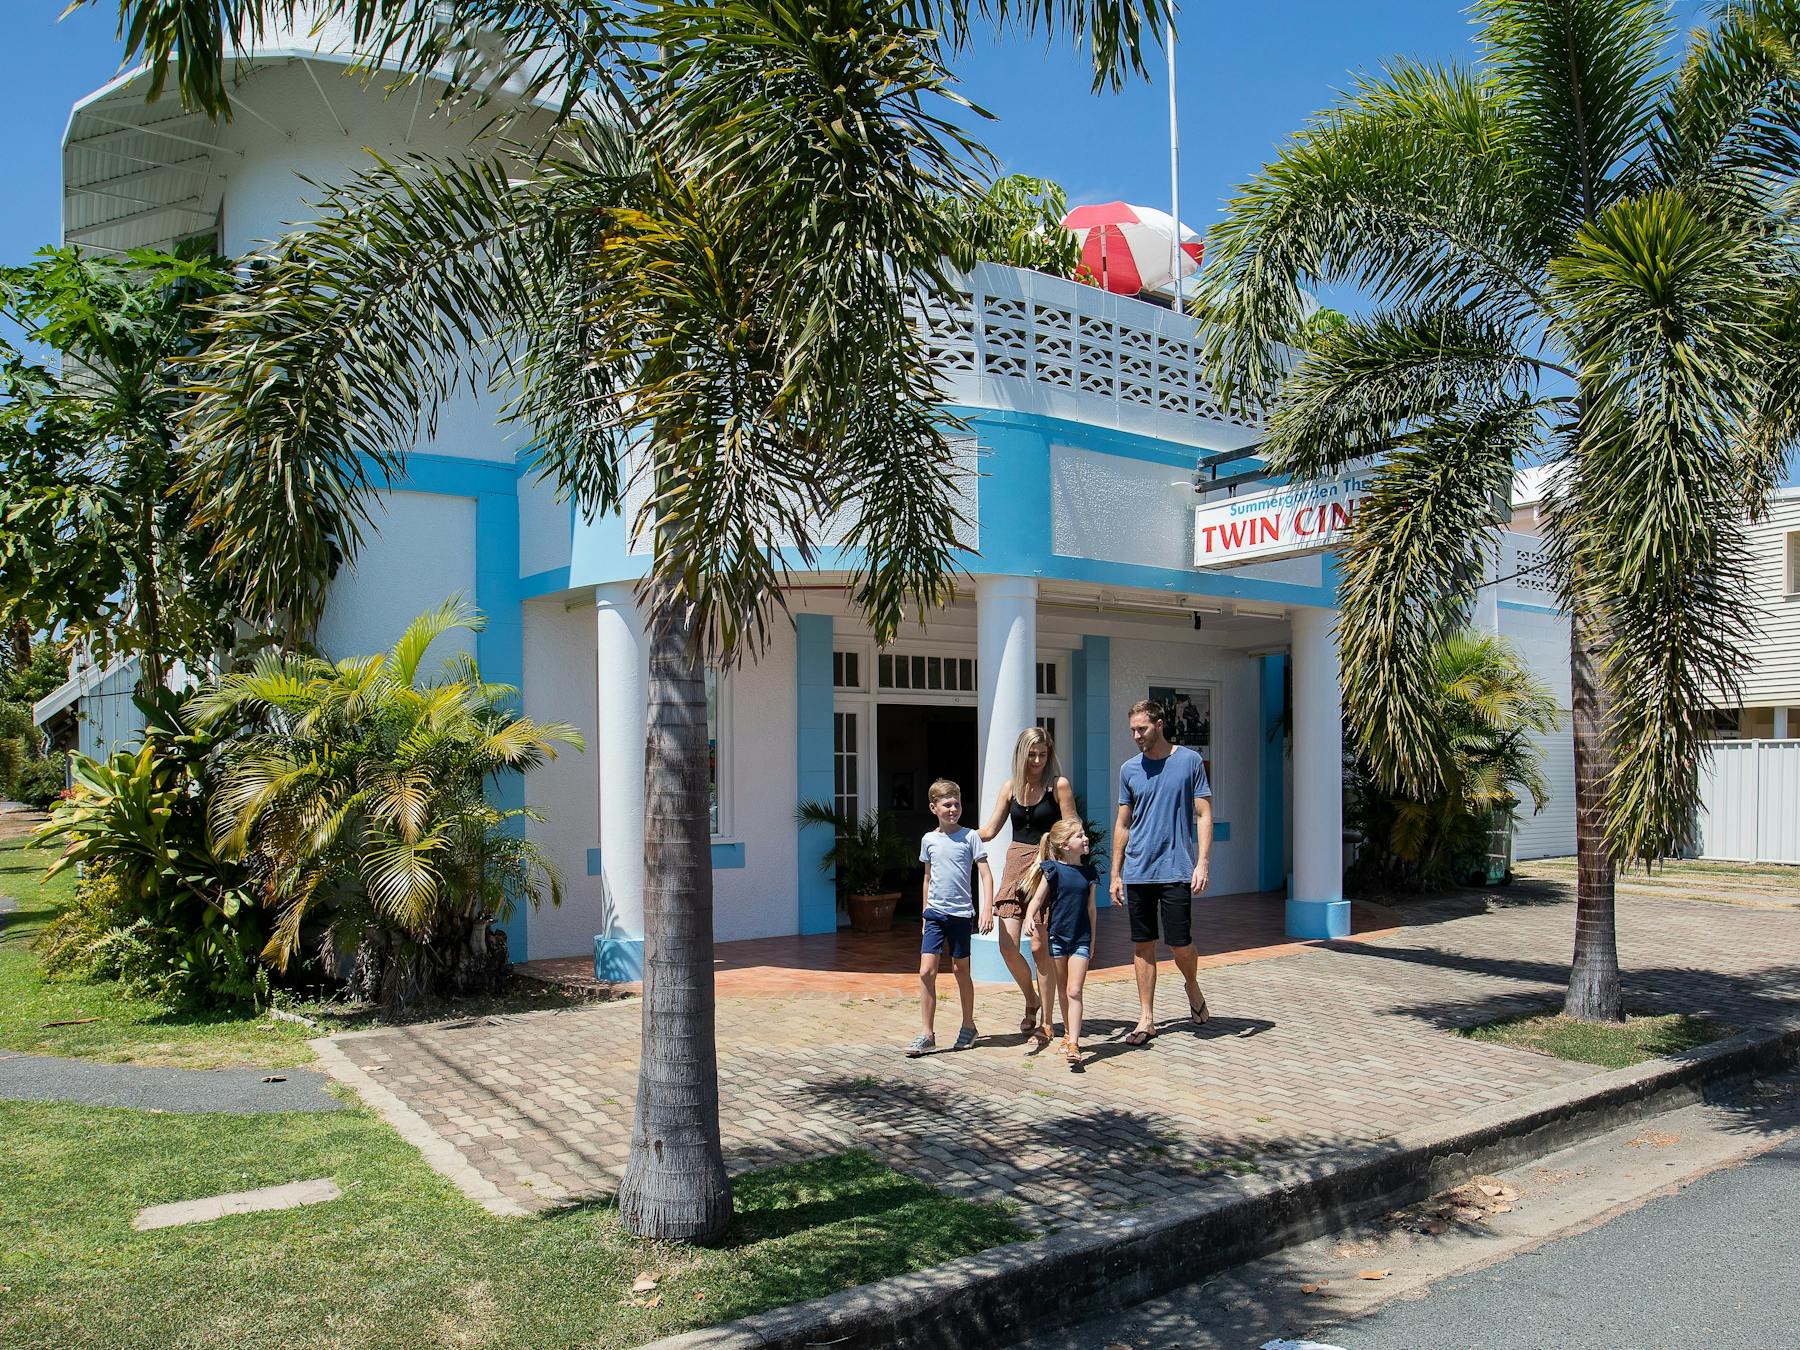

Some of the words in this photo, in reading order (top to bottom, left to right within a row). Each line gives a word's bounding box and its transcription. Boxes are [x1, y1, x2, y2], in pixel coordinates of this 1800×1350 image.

[1230, 485, 1338, 516] Summergarden
[1202, 513, 1281, 552] TWIN
[1294, 496, 1372, 536] CIN
